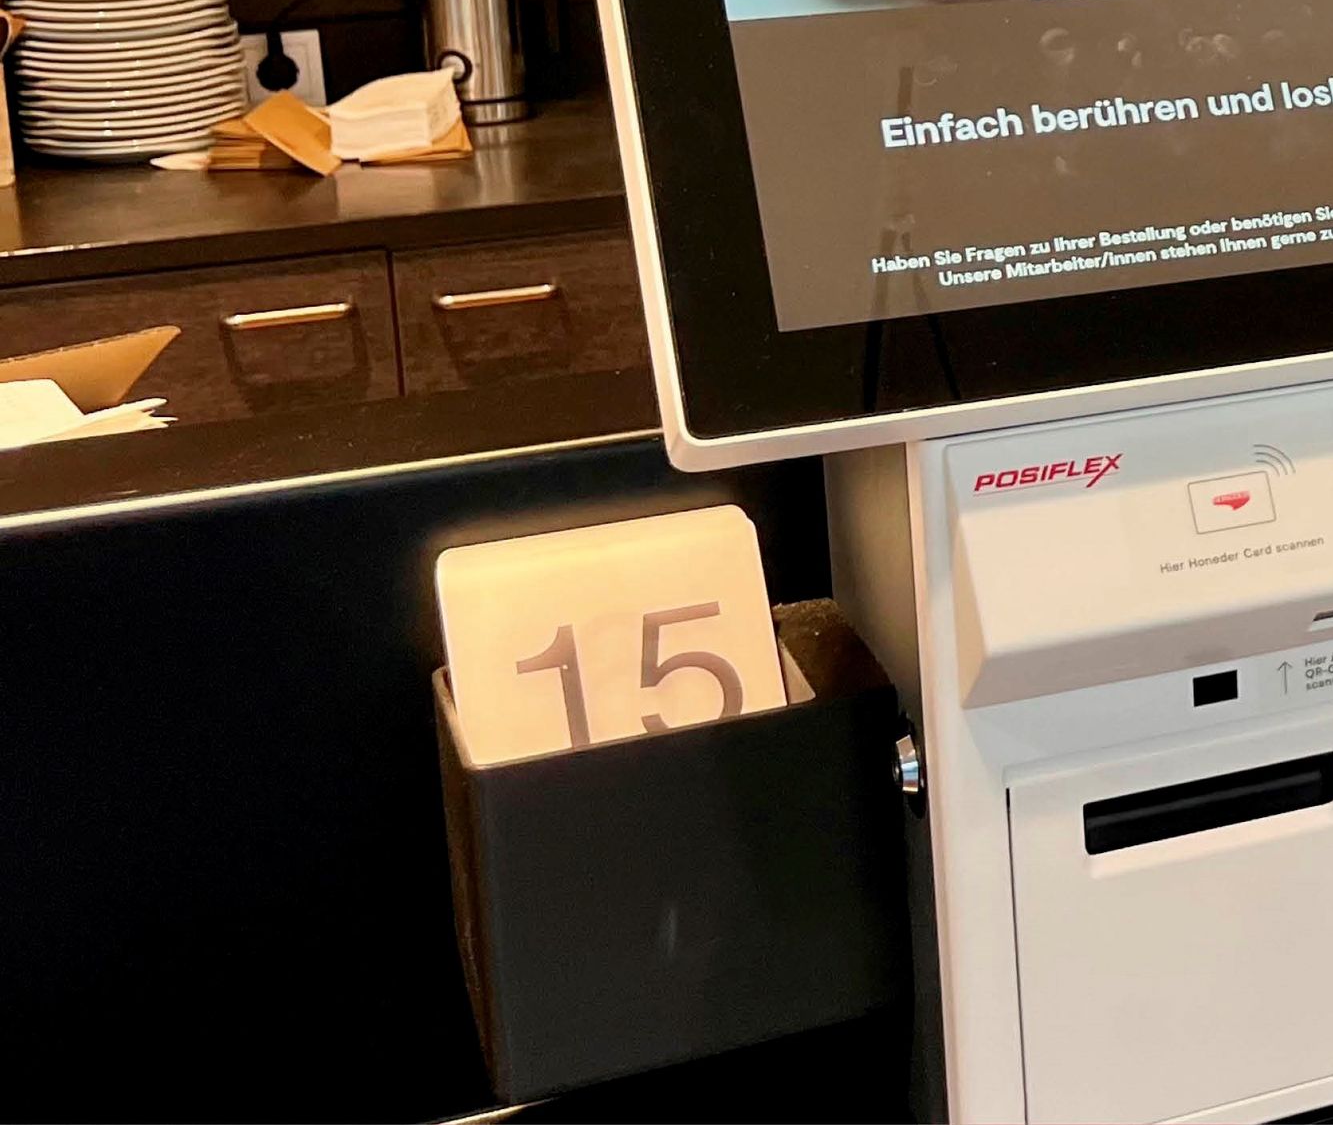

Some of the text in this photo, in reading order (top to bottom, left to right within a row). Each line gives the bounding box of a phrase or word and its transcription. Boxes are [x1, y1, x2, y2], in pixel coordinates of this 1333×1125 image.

[880, 107, 1025, 148] Einfach
[1031, 97, 1200, 134] berühren
[1207, 83, 1275, 117] und
[871, 256, 931, 274] Haben
[934, 251, 962, 266] Sie
[965, 246, 1026, 264] Fragen
[1029, 242, 1051, 255] zu
[1054, 236, 1096, 252] Ihrer
[1099, 226, 1187, 248] Bestellung
[1189, 221, 1228, 236] oder
[1230, 212, 1313, 233] benötigen
[938, 269, 1003, 286] Unsere
[1160, 243, 1218, 260] stehen
[1220, 235, 1268, 253] Ihnen
[1270, 230, 1317, 250] gerne
[974, 453, 1124, 492] POSIFLEX
[1160, 536, 1325, 574] Hier Honeder Card scannen
[516, 601, 743, 747] 15
[1304, 656, 1327, 667] Hier
